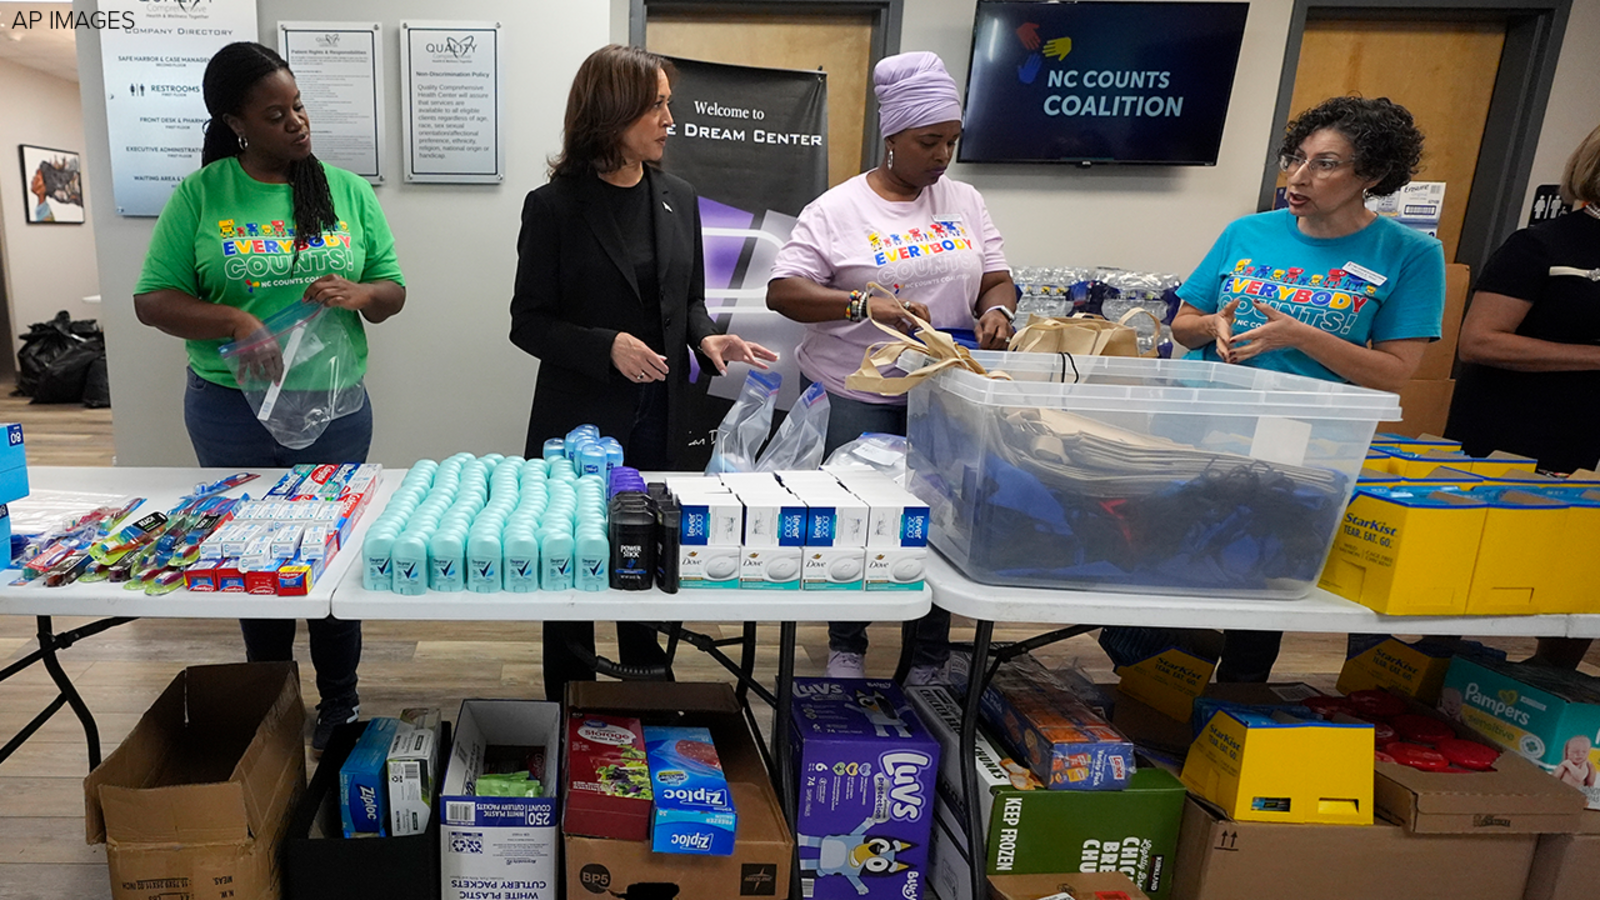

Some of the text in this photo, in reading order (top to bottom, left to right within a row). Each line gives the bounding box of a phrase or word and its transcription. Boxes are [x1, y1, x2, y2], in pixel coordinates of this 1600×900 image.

[177, 28, 233, 36] DIRECTORY
[426, 43, 477, 53] QUALITY
[151, 85, 200, 93] RESTROOMS
[1048, 70, 1171, 89] NC COUNTS
[694, 100, 765, 120] Welcome to
[1043, 96, 1183, 117] COALITION
[685, 123, 822, 146] DREAM CENTER
[1404, 184, 1429, 193] Ensure
[223, 235, 351, 256] EVERYBODY
[874, 238, 972, 266] EVERYBODY
[225, 249, 354, 280] COUNTS!
[273, 278, 304, 286] COUNTS
[914, 279, 940, 288] COUNTS
[1224, 278, 1367, 314] EVERYBODY
[10, 432, 22, 444] 80
[688, 513, 696, 537] lever
[696, 514, 704, 536] 2000
[784, 516, 792, 538] 2000
[792, 515, 801, 538] lever
[812, 515, 822, 538] lever
[822, 516, 830, 538] 2000
[906, 516, 915, 538] 2000
[914, 516, 924, 539] lever
[1344, 512, 1397, 536] StarKist
[1344, 525, 1392, 549] TEAR. EAT. GO.
[1157, 657, 1202, 680] StarKist
[1376, 648, 1418, 674] StarKist
[1155, 664, 1170, 674] TEAR.
[1172, 672, 1185, 680] EAT.
[1186, 678, 1196, 686] GO.
[792, 681, 843, 698] Luvs
[1465, 682, 1531, 726] Pampers
[584, 728, 630, 740] Storage
[1210, 724, 1240, 750] StarKist
[1468, 714, 1516, 741] sensitive
[816, 762, 828, 772] 6
[1093, 750, 1105, 786] Variety Pack
[1113, 757, 1123, 778] Lance
[807, 776, 816, 786] 74
[882, 752, 929, 820] Luvs
[359, 786, 378, 820] Ziploc
[664, 788, 723, 804] Ziploc
[875, 777, 886, 819] protection
[528, 812, 550, 826] 250
[671, 832, 709, 848] Ziploc
[996, 798, 1022, 870] KEEP FROZEN
[1137, 838, 1152, 870] Lightly
[213, 876, 233, 885] MEAS.
[451, 880, 546, 889] CUTLERY PACKETS
[582, 872, 609, 885] BP5
[1150, 856, 1163, 891] KIRKLAND
[459, 891, 538, 900] WHITE PLASTIC
